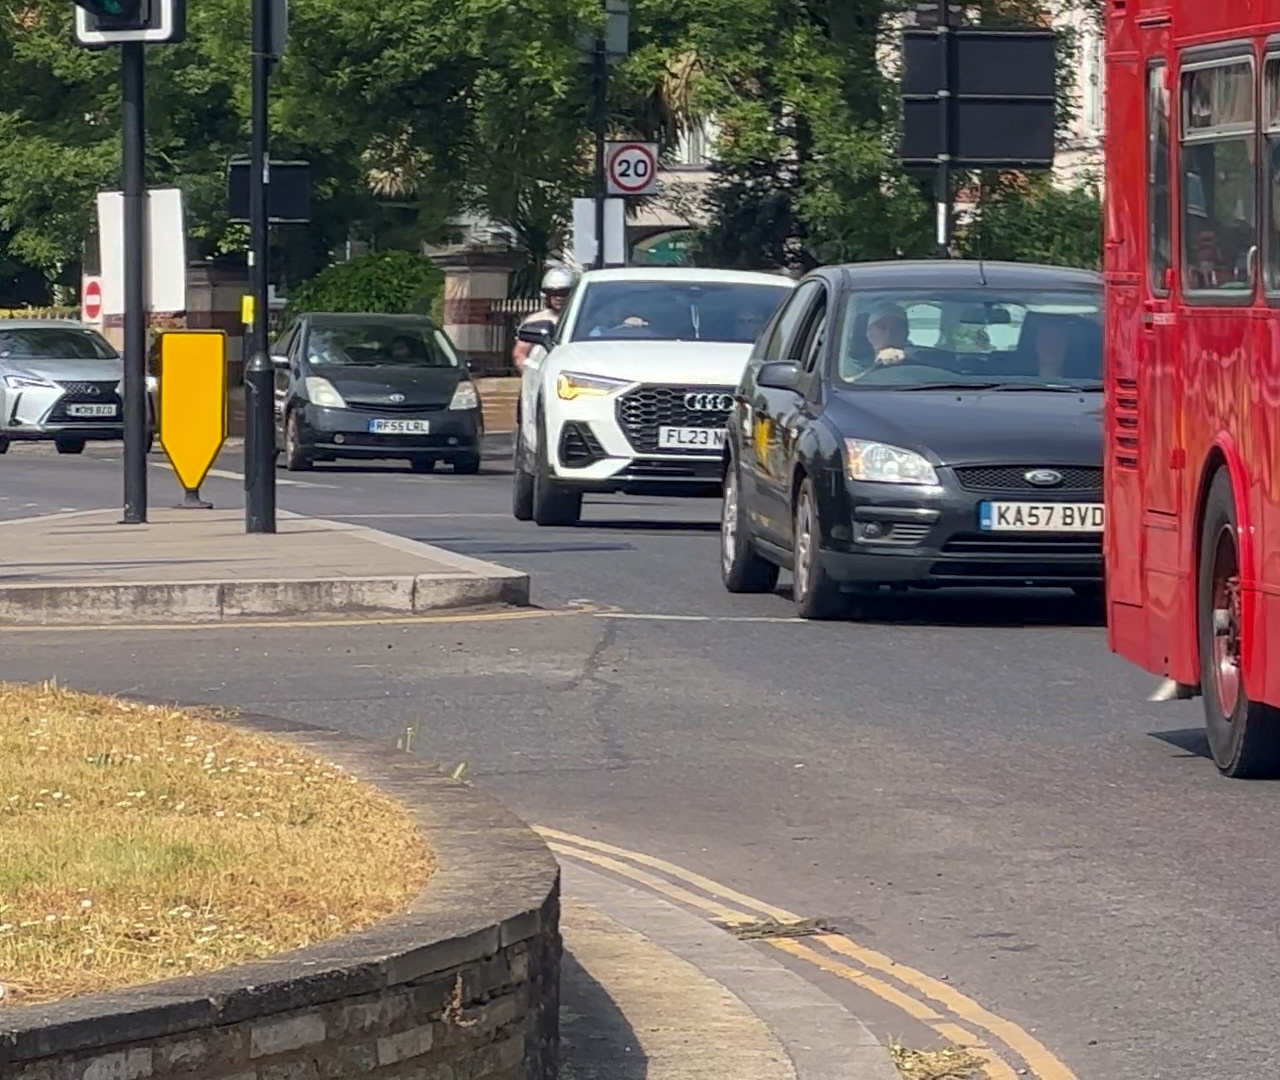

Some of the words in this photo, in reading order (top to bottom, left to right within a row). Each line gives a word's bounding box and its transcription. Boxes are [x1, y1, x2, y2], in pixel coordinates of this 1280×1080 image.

[617, 159, 649, 178] 20
[666, 428, 709, 445] FL23
[997, 505, 1054, 526] KA57
[1062, 506, 1104, 527] BVD
